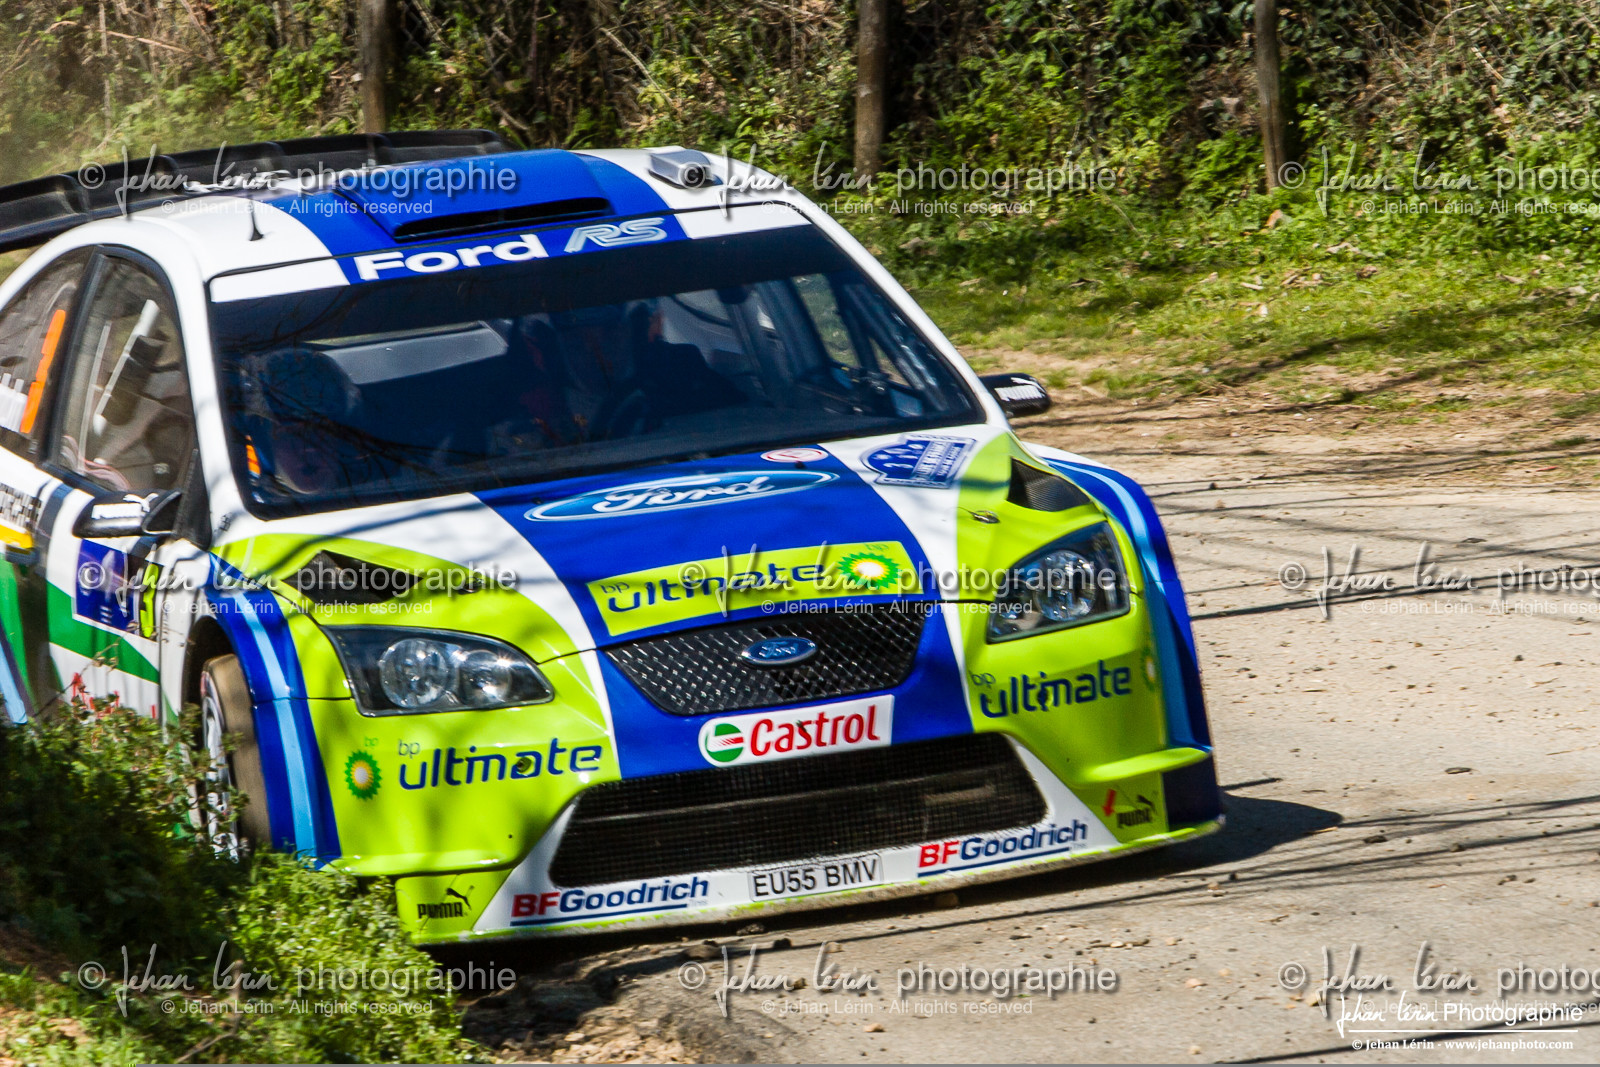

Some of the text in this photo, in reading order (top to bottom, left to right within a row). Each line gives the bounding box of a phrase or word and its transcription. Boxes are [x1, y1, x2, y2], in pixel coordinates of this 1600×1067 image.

[353, 217, 669, 281] Ford RS
[592, 475, 774, 514] Ford
[600, 581, 630, 595] bp
[608, 562, 825, 613] ultimate
[970, 671, 996, 689] bp
[979, 660, 1131, 718] ultimate
[398, 739, 421, 759] bp
[750, 705, 880, 756] Castrol
[399, 738, 603, 790] ultimate
[917, 819, 1088, 868] BFGoodrich
[511, 875, 709, 918] BFGoodrich
[753, 859, 880, 898] EU55 BMV
